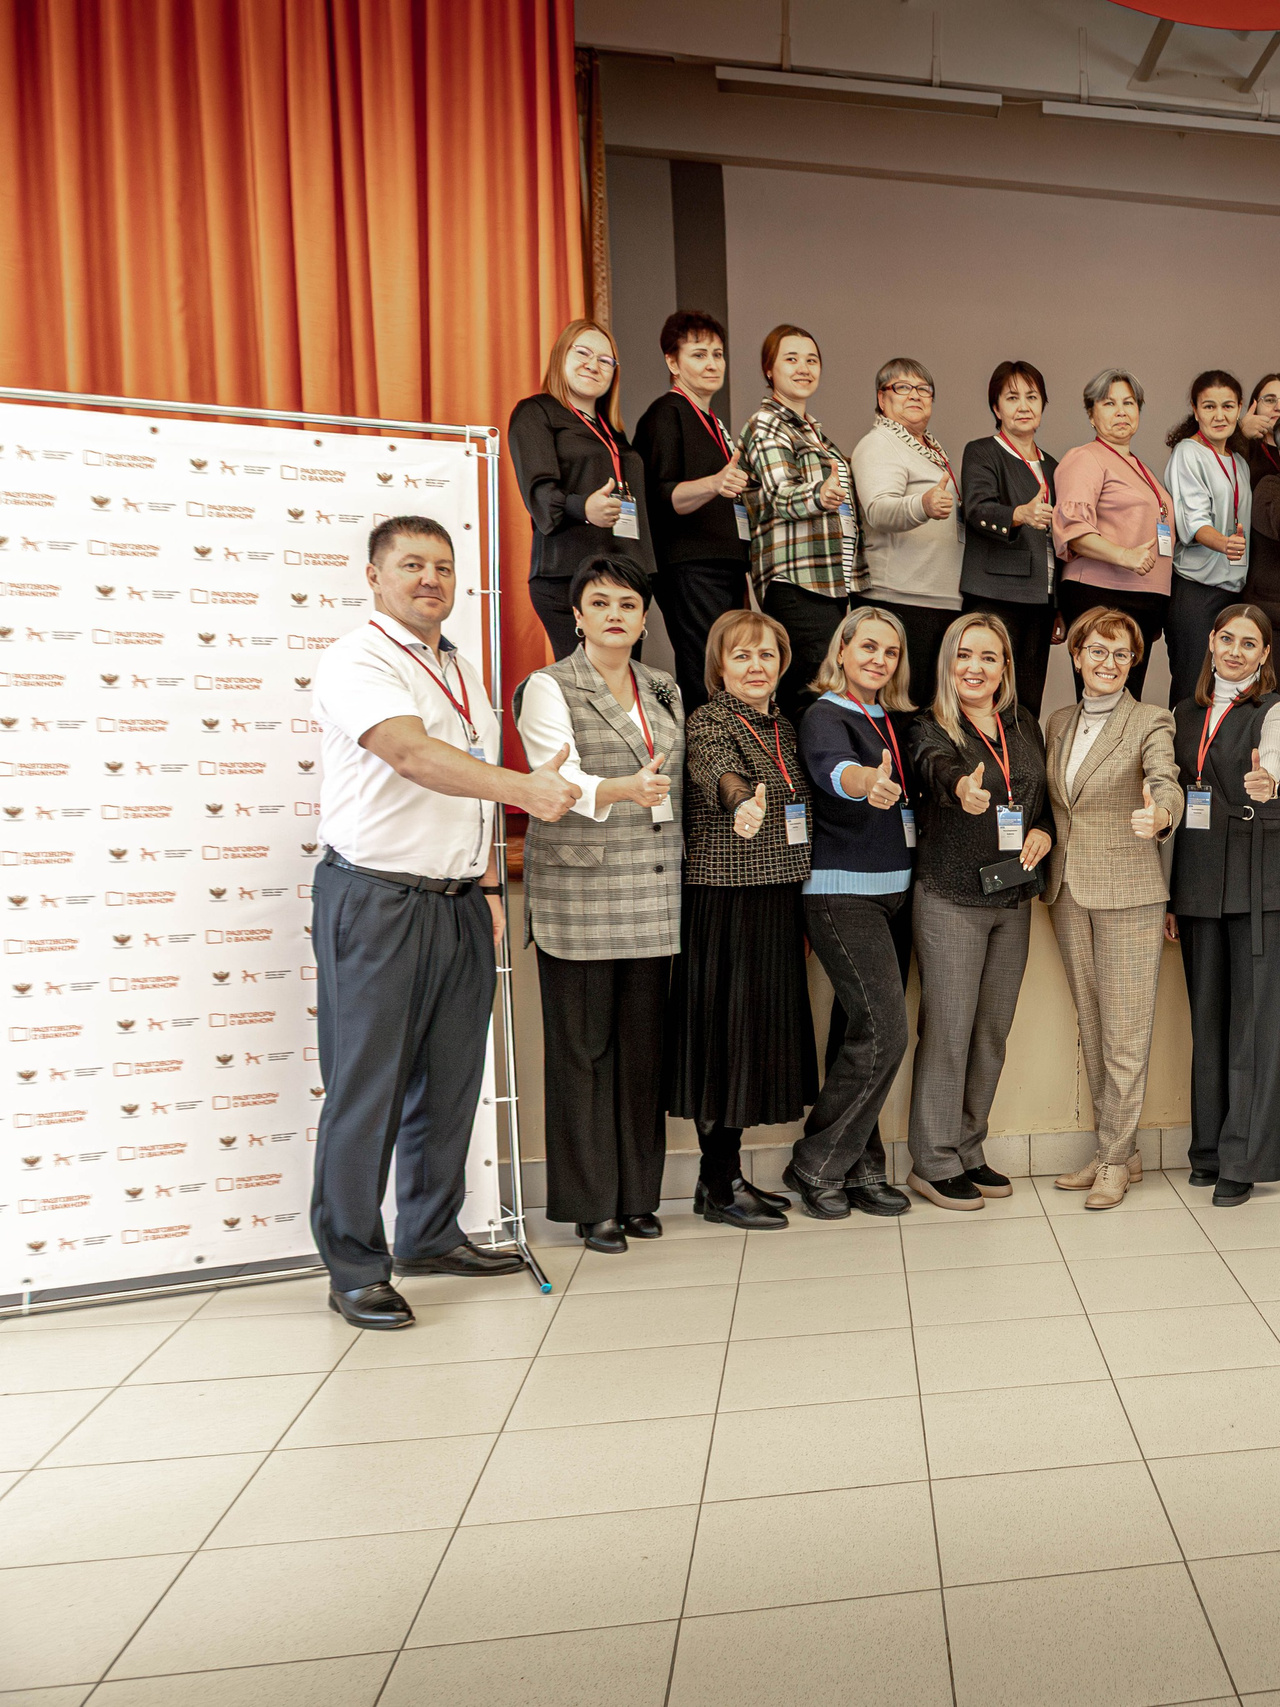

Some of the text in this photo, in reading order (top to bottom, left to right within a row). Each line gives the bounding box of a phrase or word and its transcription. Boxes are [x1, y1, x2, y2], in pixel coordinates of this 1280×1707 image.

[300, 468, 346, 477] РАЗГОВОРЫ
[308, 475, 344, 483] ВАЖНОМ
[207, 504, 255, 513] РАЗГОВОРЫ
[215, 512, 253, 520] ВАЖНОМ
[304, 552, 350, 561] РАЗГОВОРЫ
[311, 559, 347, 567] ВАЖНОМ
[212, 591, 259, 599] РАЗГОВОРЫ
[223, 845, 270, 853] РАЗГОВОРЫ
[226, 928, 273, 937] РАЗГОВОРЫ
[233, 935, 271, 943] ВАЖНОМ
[229, 1010, 276, 1020] РАЗГОВОРЫ
[237, 1017, 274, 1026] ВАЖНОМ
[232, 1091, 280, 1102] РАЗГОВОРЫ
[240, 1098, 277, 1108] ВАЖНОМ
[236, 1172, 283, 1184] РАЗГОВОРЫ
[243, 1179, 280, 1189] ВАЖНОМ
